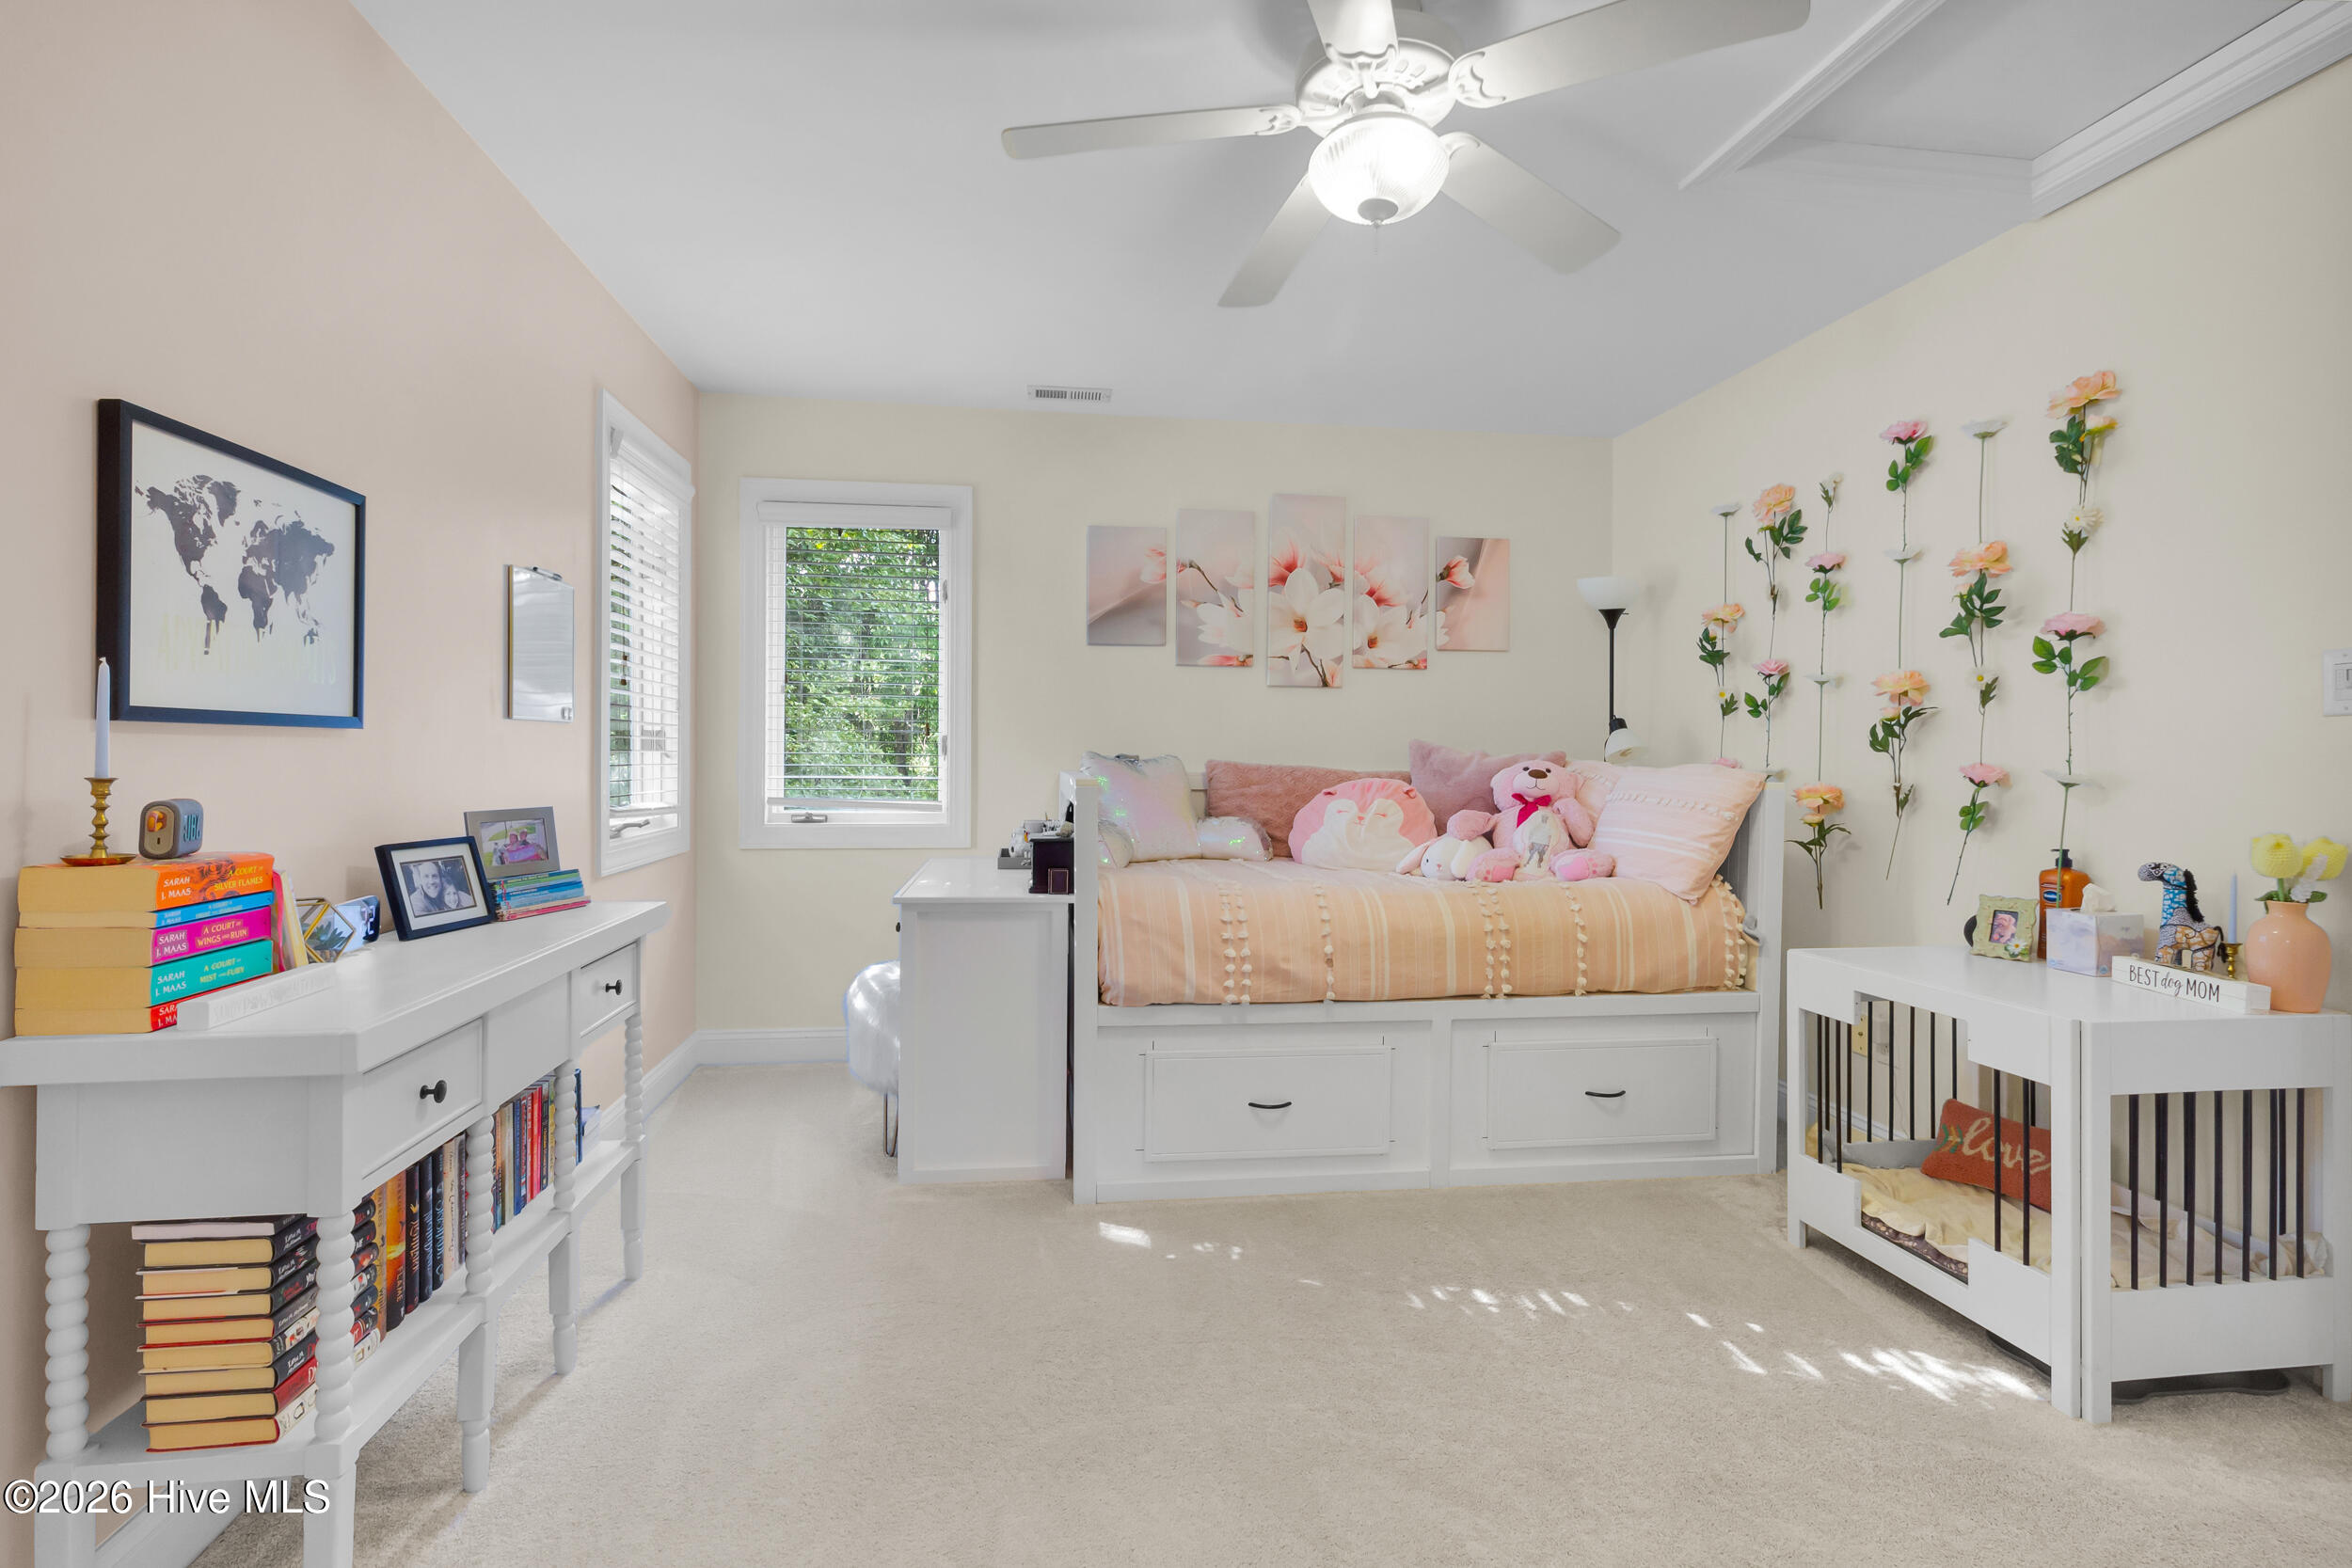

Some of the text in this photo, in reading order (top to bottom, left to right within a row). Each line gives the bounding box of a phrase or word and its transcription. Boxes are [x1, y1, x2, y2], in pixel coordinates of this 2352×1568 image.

[234, 865, 257, 876] COURT
[163, 876, 191, 888] SARAH
[214, 876, 263, 892] SILVER FLAMES
[167, 887, 192, 898] MAAS
[211, 920, 235, 933] COURT
[158, 930, 186, 945] SARAH
[197, 934, 221, 947] WINGS
[230, 928, 247, 940] RUIN
[164, 942, 187, 955] MAAS
[210, 958, 236, 971] COURT
[157, 970, 186, 985] SARAH
[2129, 964, 2220, 1003] BEST dog MOM
[163, 980, 187, 993] MAAS
[159, 1004, 177, 1016] SAR
[165, 1014, 177, 1025] MA
[1962, 1117, 2051, 1175] love
